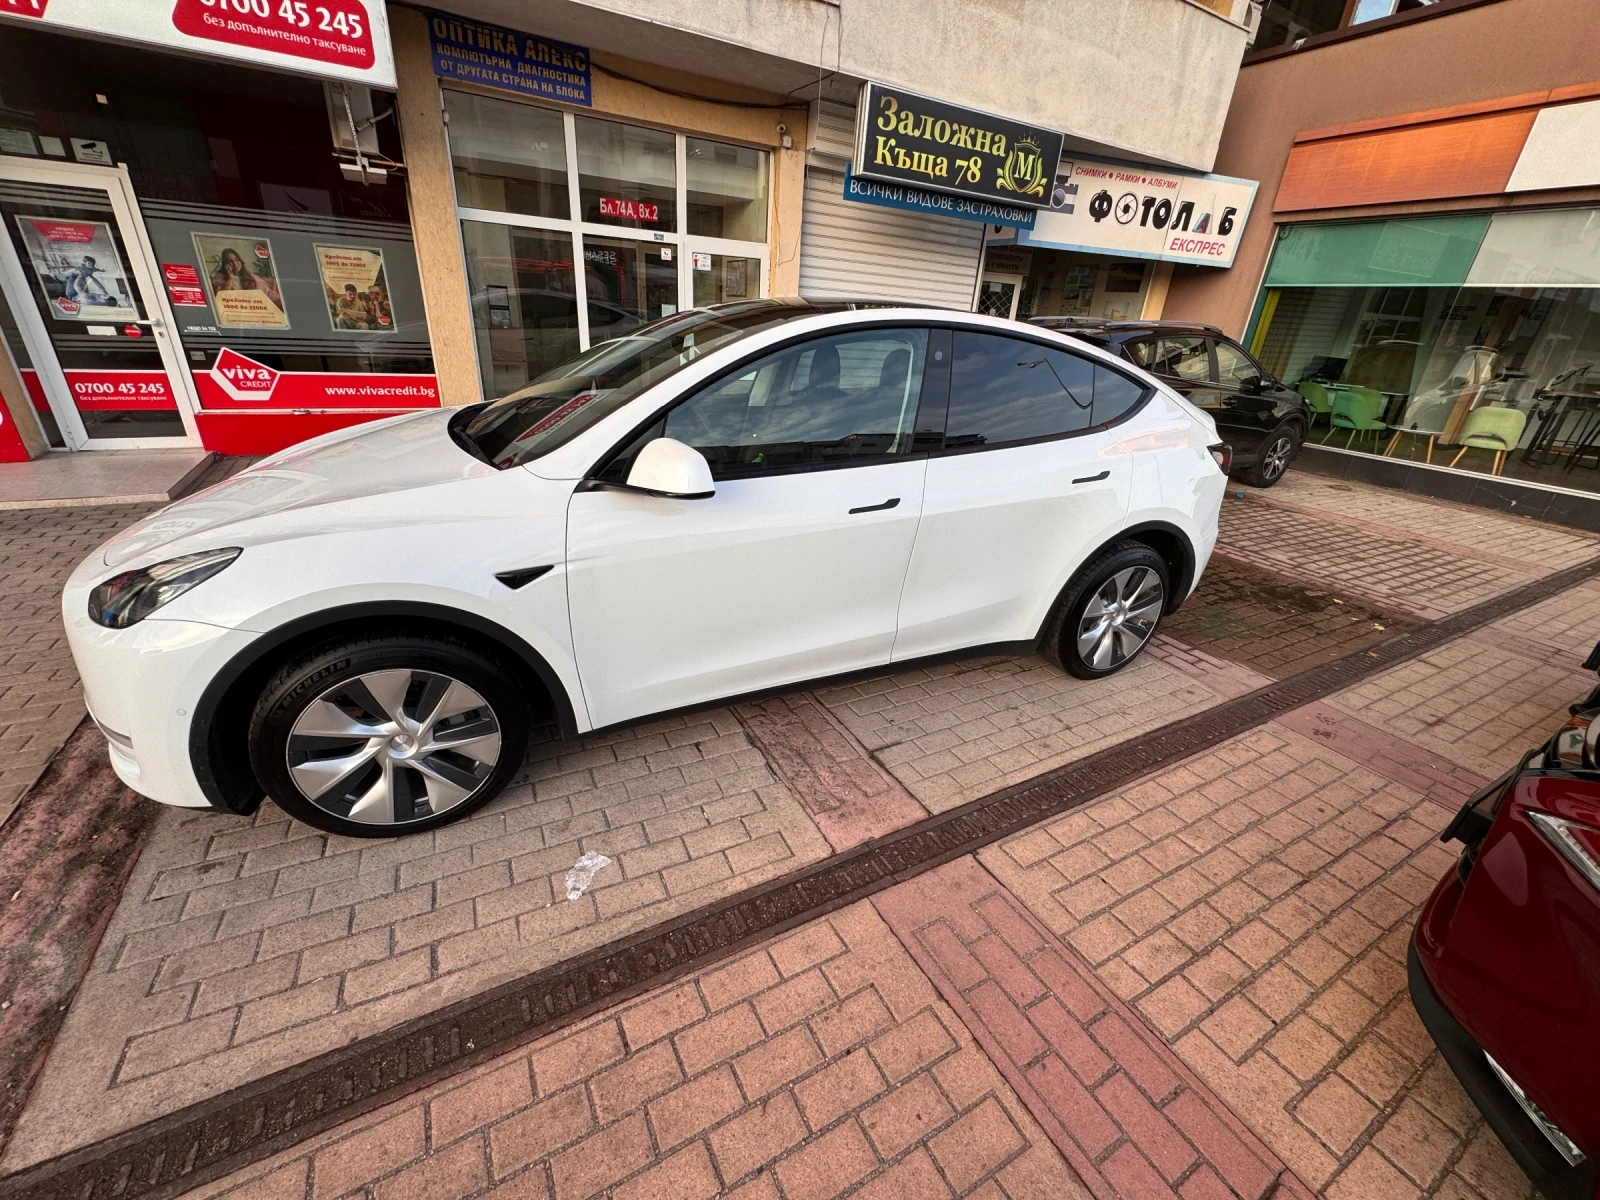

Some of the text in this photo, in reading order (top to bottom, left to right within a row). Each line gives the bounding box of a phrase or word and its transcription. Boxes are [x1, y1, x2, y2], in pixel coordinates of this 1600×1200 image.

[203, 13, 367, 56] без допълнително таксуване
[278, 0, 310, 27] 45
[315, 7, 363, 38] 245
[433, 17, 586, 72] ОПТИКА АЛЕКС
[437, 43, 586, 87] КОМПЮТЪРНА ДИАГНОСТИКА
[440, 59, 585, 100] ОТ ДРУГАТА СТРАНА НА БЛОКА
[877, 95, 1006, 157] Заложна
[873, 135, 982, 186] Къща 78
[1075, 166, 1178, 190] СНИМКИ РАМКИ АЛБУМИ
[599, 198, 637, 219] Бл.74А,
[850, 179, 1032, 224] ВСИЧКИ ВИДОВЕ ЗАСТРАХОВКИ
[1169, 237, 1226, 256] ЕКСПРЕС
[75, 383, 165, 394] 0700 45 245
[222, 365, 272, 381] viva
[324, 385, 436, 398] www.vivacredit.bg
[284, 660, 346, 707] MICHELIN
